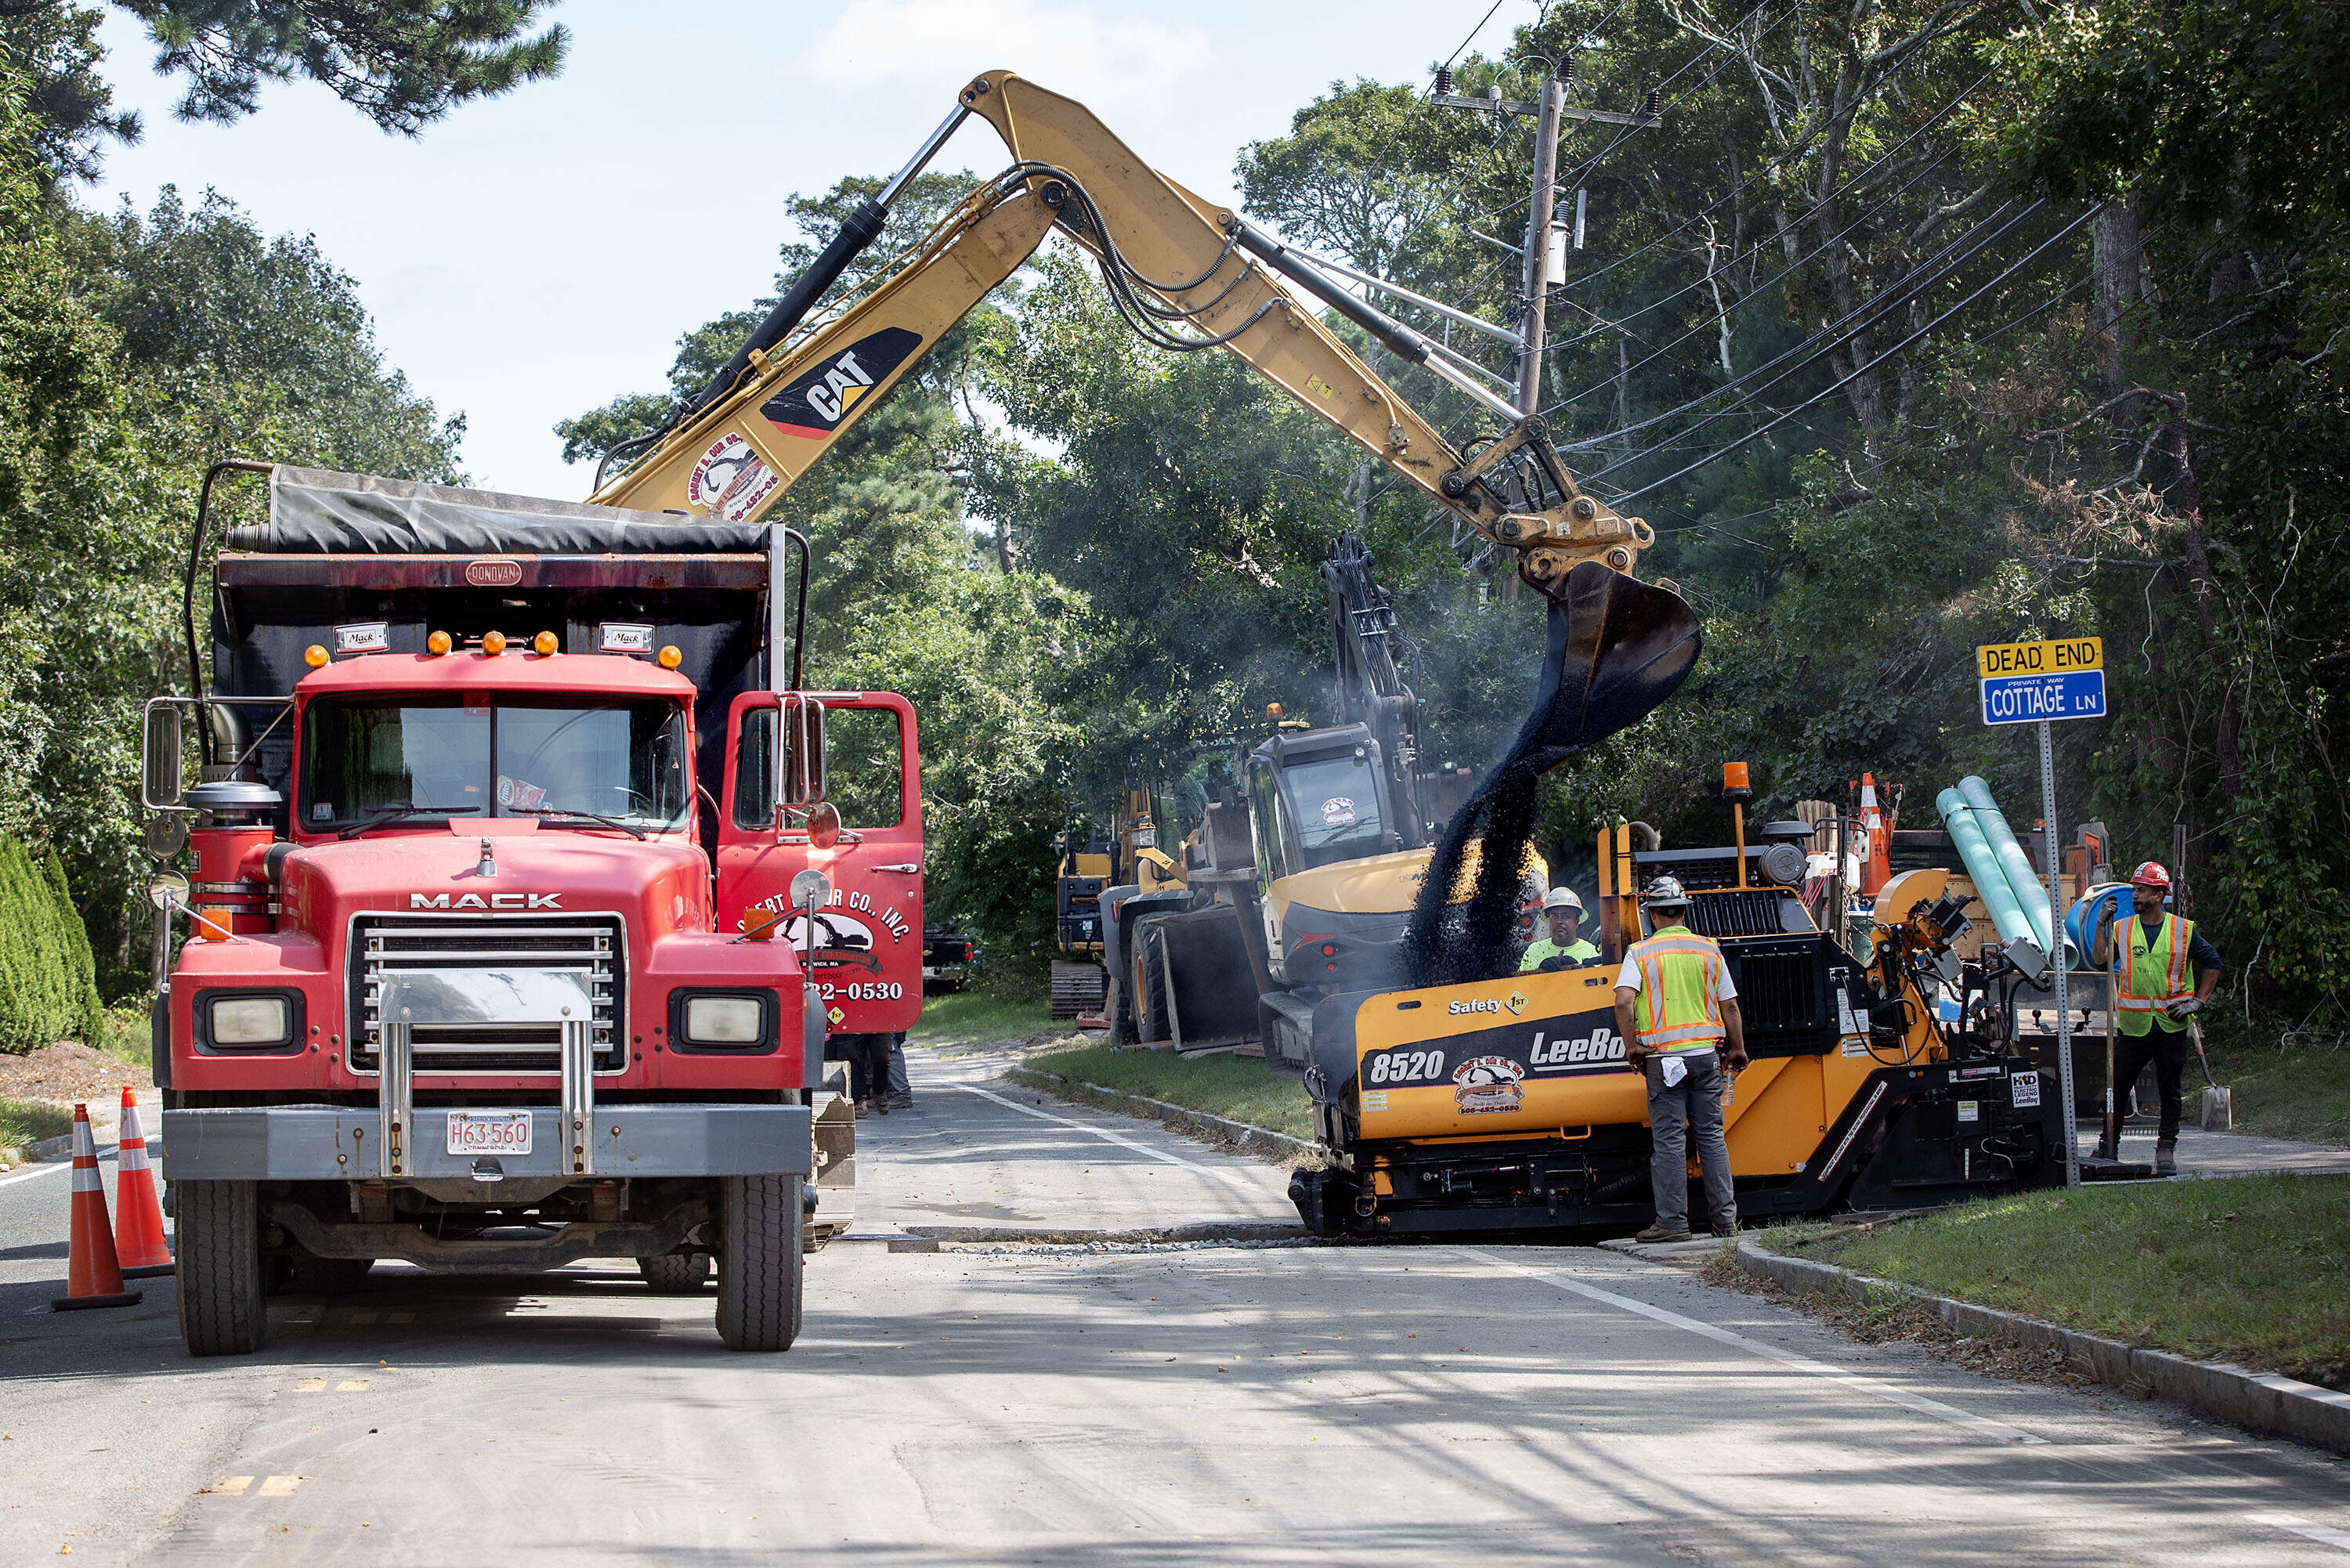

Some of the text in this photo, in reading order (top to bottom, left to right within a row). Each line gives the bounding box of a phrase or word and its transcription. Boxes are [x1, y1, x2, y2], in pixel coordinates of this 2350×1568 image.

[806, 350, 874, 421] CAT
[690, 467, 704, 500] ROBERT
[709, 442, 725, 457] OUR
[715, 500, 725, 511] SITE
[728, 480, 741, 495] UTILITY
[472, 566, 515, 581] DONOVAN
[349, 634, 374, 643] Mack
[614, 634, 639, 643] Mack
[1987, 642, 2095, 672] DEAD END
[1991, 685, 2095, 717] COTTAGE LN
[410, 893, 562, 909] MACK
[880, 906, 909, 943] INC.
[1449, 996, 1525, 1015] Safety 1ST
[1371, 1028, 1626, 1083] 8520 LeeBo
[1454, 1061, 1475, 1078] ROBERT
